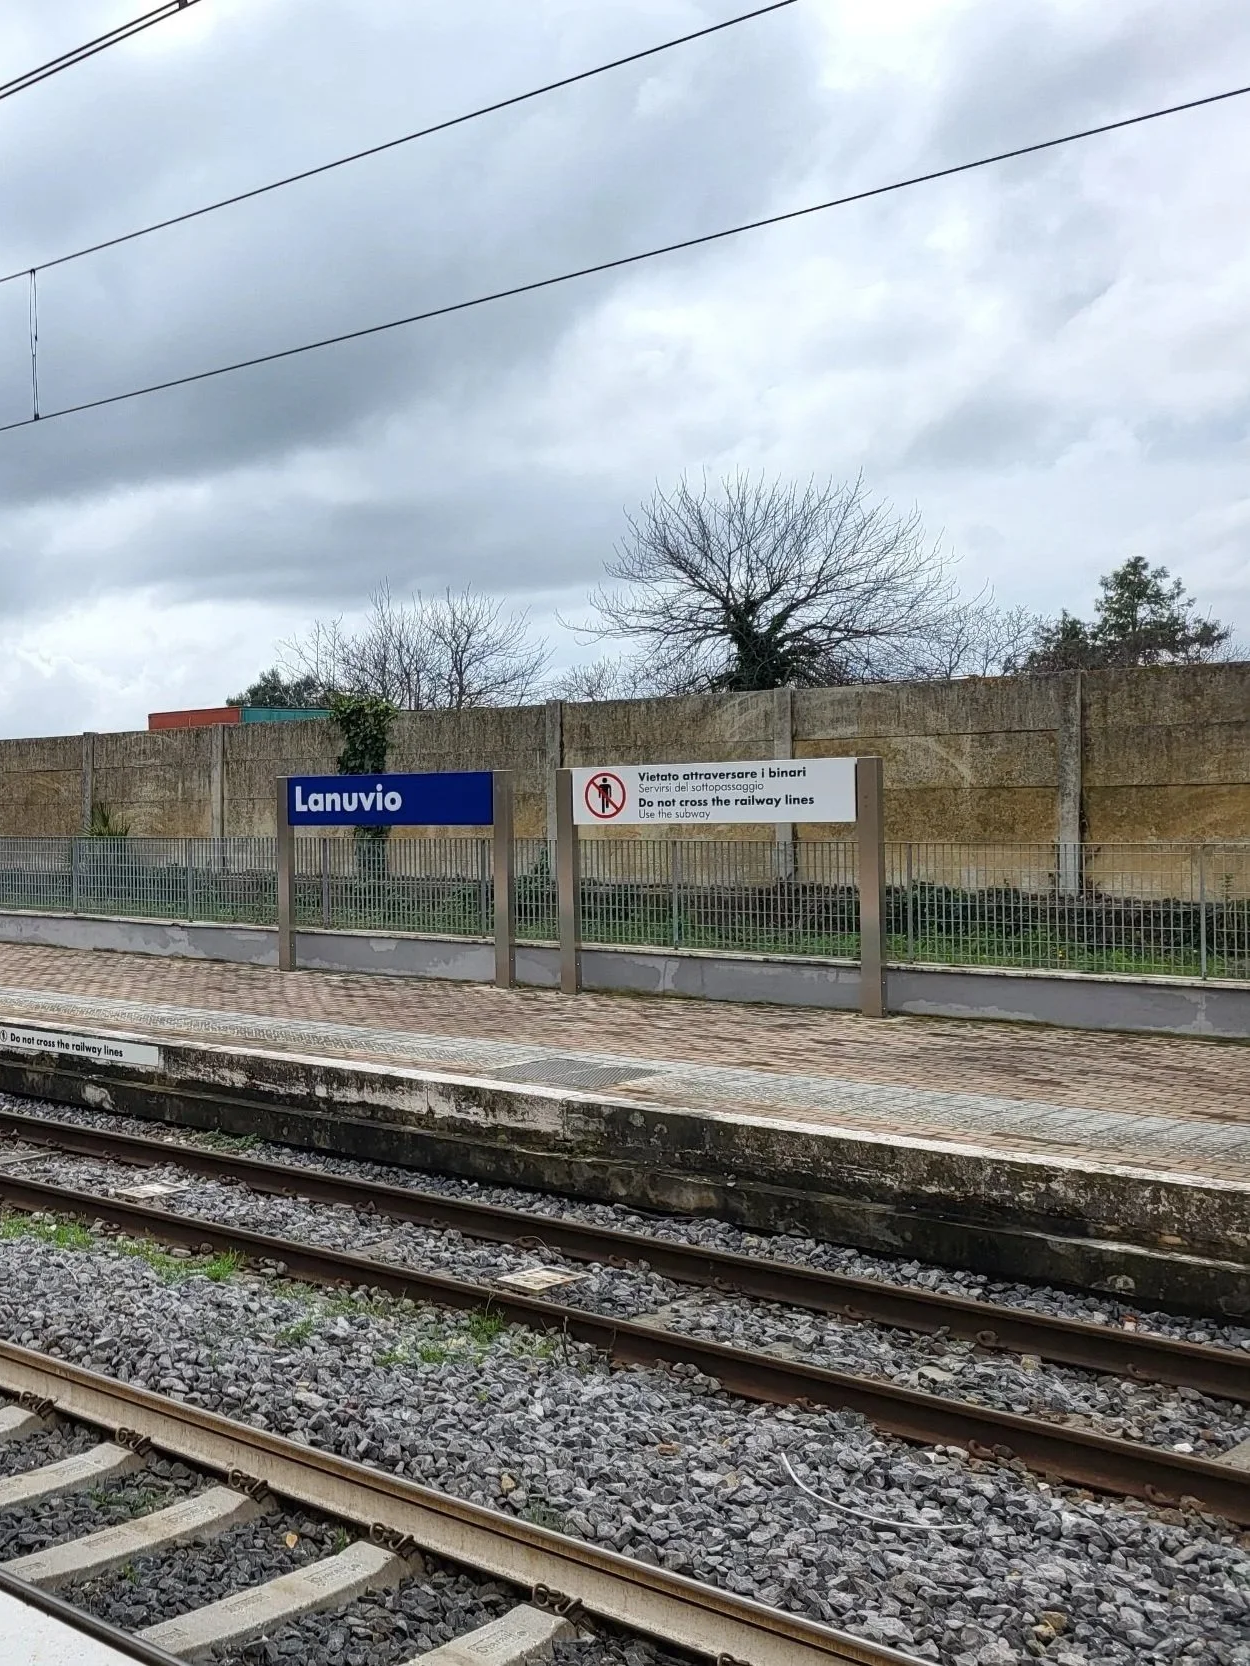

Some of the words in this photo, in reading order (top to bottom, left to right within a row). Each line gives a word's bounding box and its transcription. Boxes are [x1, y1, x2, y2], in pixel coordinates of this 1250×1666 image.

[638, 771, 679, 782] Vietato
[683, 770, 757, 781] attraversare
[761, 768, 765, 778] i
[769, 767, 806, 778] binari
[638, 782, 672, 793] Servirsi
[675, 781, 689, 792] del
[691, 780, 764, 793] sottopassaggio
[295, 783, 403, 812] Lanuvio
[638, 797, 654, 807] Do
[658, 798, 676, 807] not
[680, 799, 709, 807] cross
[711, 796, 731, 806] the
[735, 794, 782, 808] railway
[785, 794, 815, 805] lines
[639, 809, 655, 819] Use
[658, 808, 673, 818] the
[675, 808, 710, 820] subway
[10, 1033, 21, 1043] Do
[22, 1037, 35, 1045] not
[36, 1039, 56, 1048] cross
[57, 1039, 70, 1050] the
[71, 1042, 103, 1056] railway
[103, 1044, 123, 1057] lines
